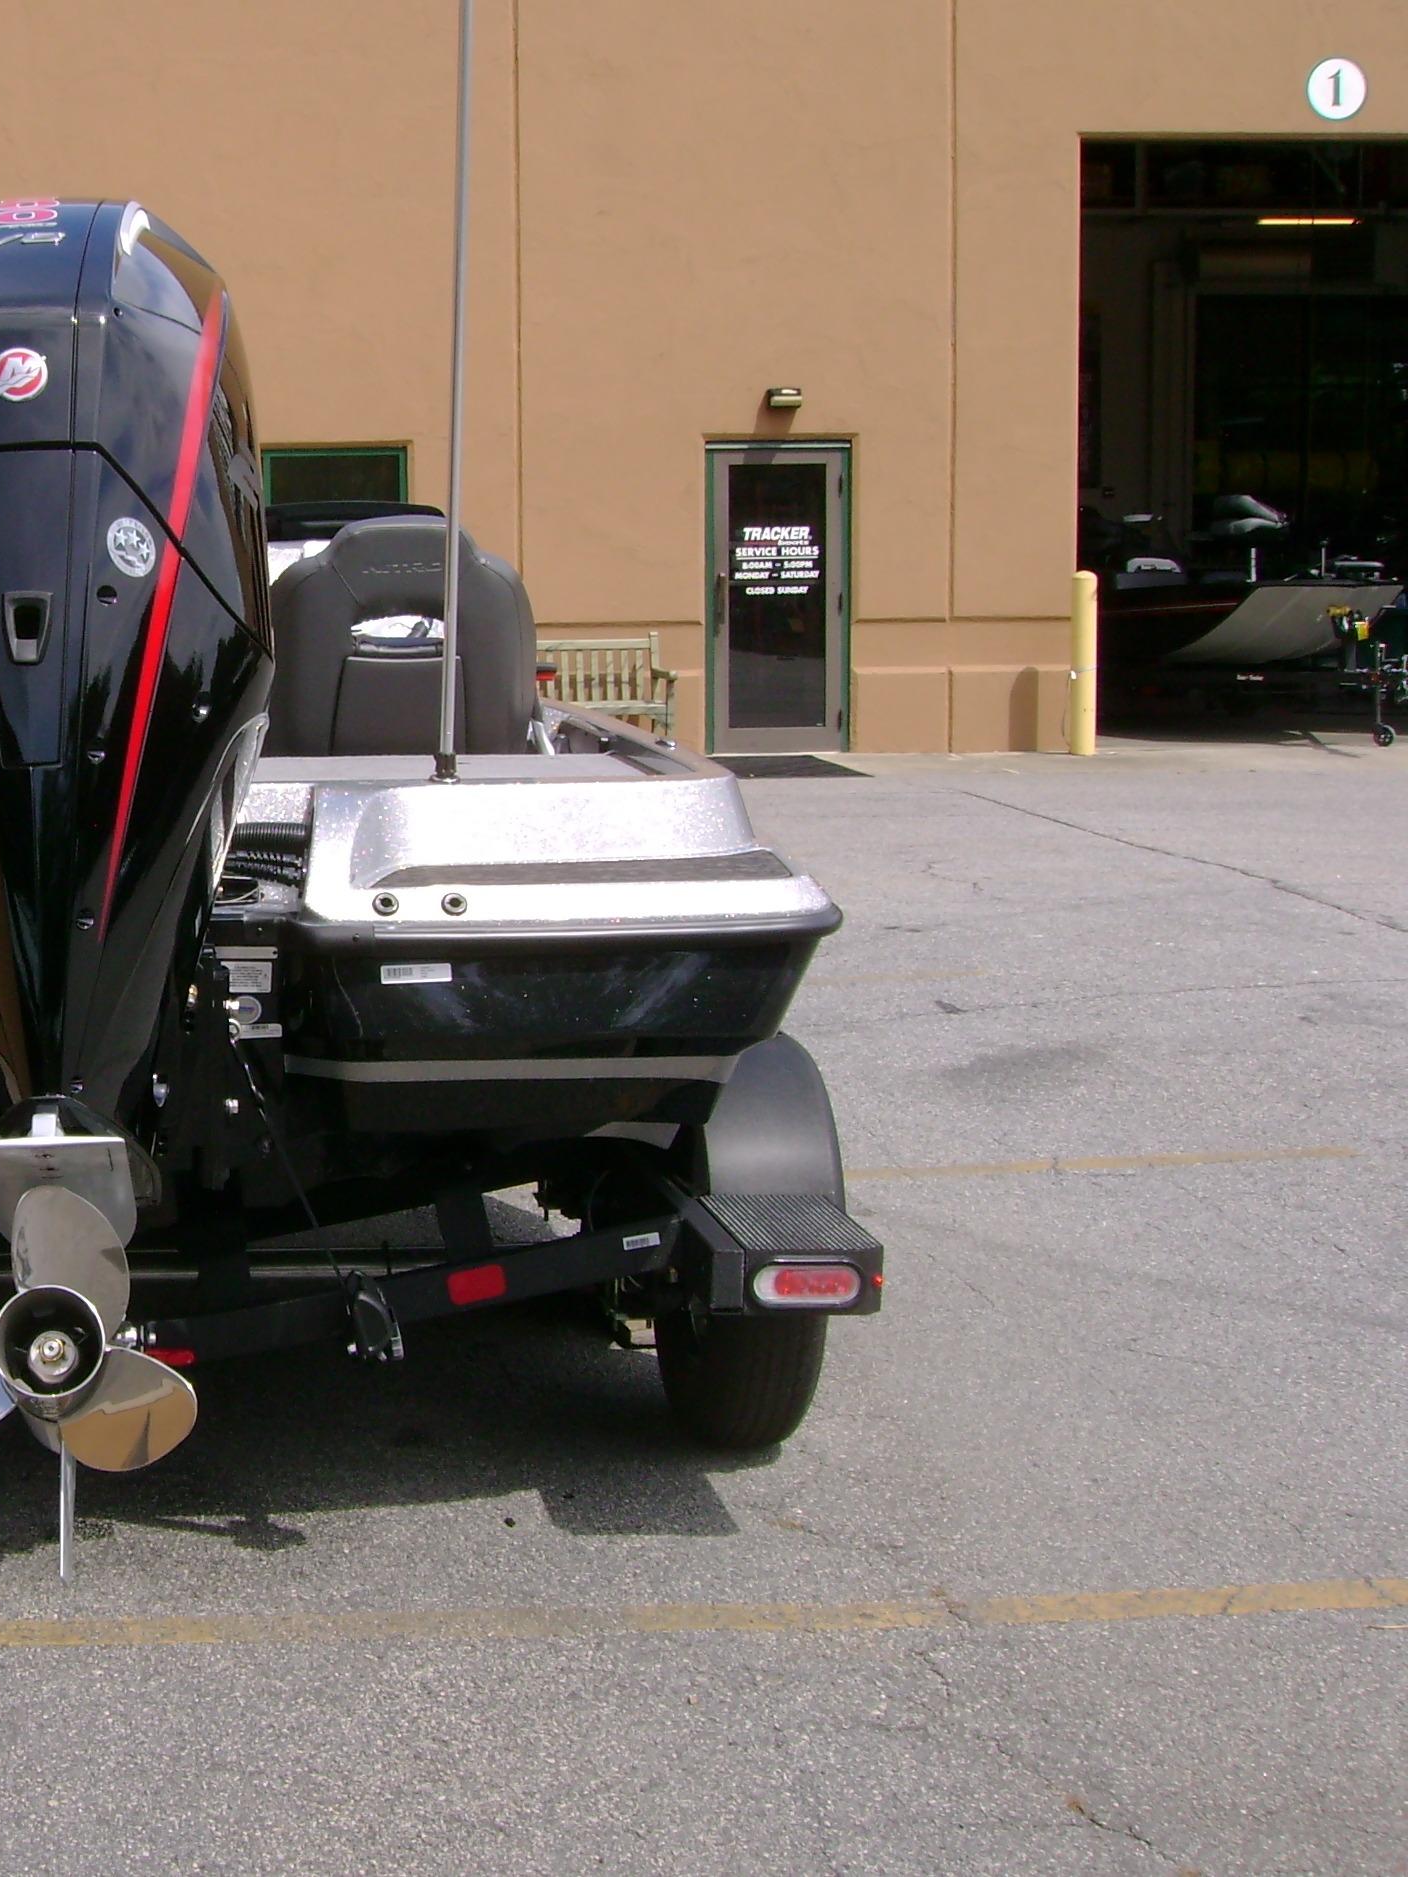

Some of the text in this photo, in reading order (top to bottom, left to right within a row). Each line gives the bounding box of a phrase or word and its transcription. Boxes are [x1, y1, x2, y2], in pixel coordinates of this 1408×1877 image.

[1327, 68, 1341, 107] 1
[743, 526, 810, 541] TRACKER
[735, 545, 820, 557] SERVICE HOURS
[734, 571, 770, 580] MONDAY
[780, 570, 820, 579] SATURDAY
[745, 585, 809, 595] CLOSED SUNDAY
